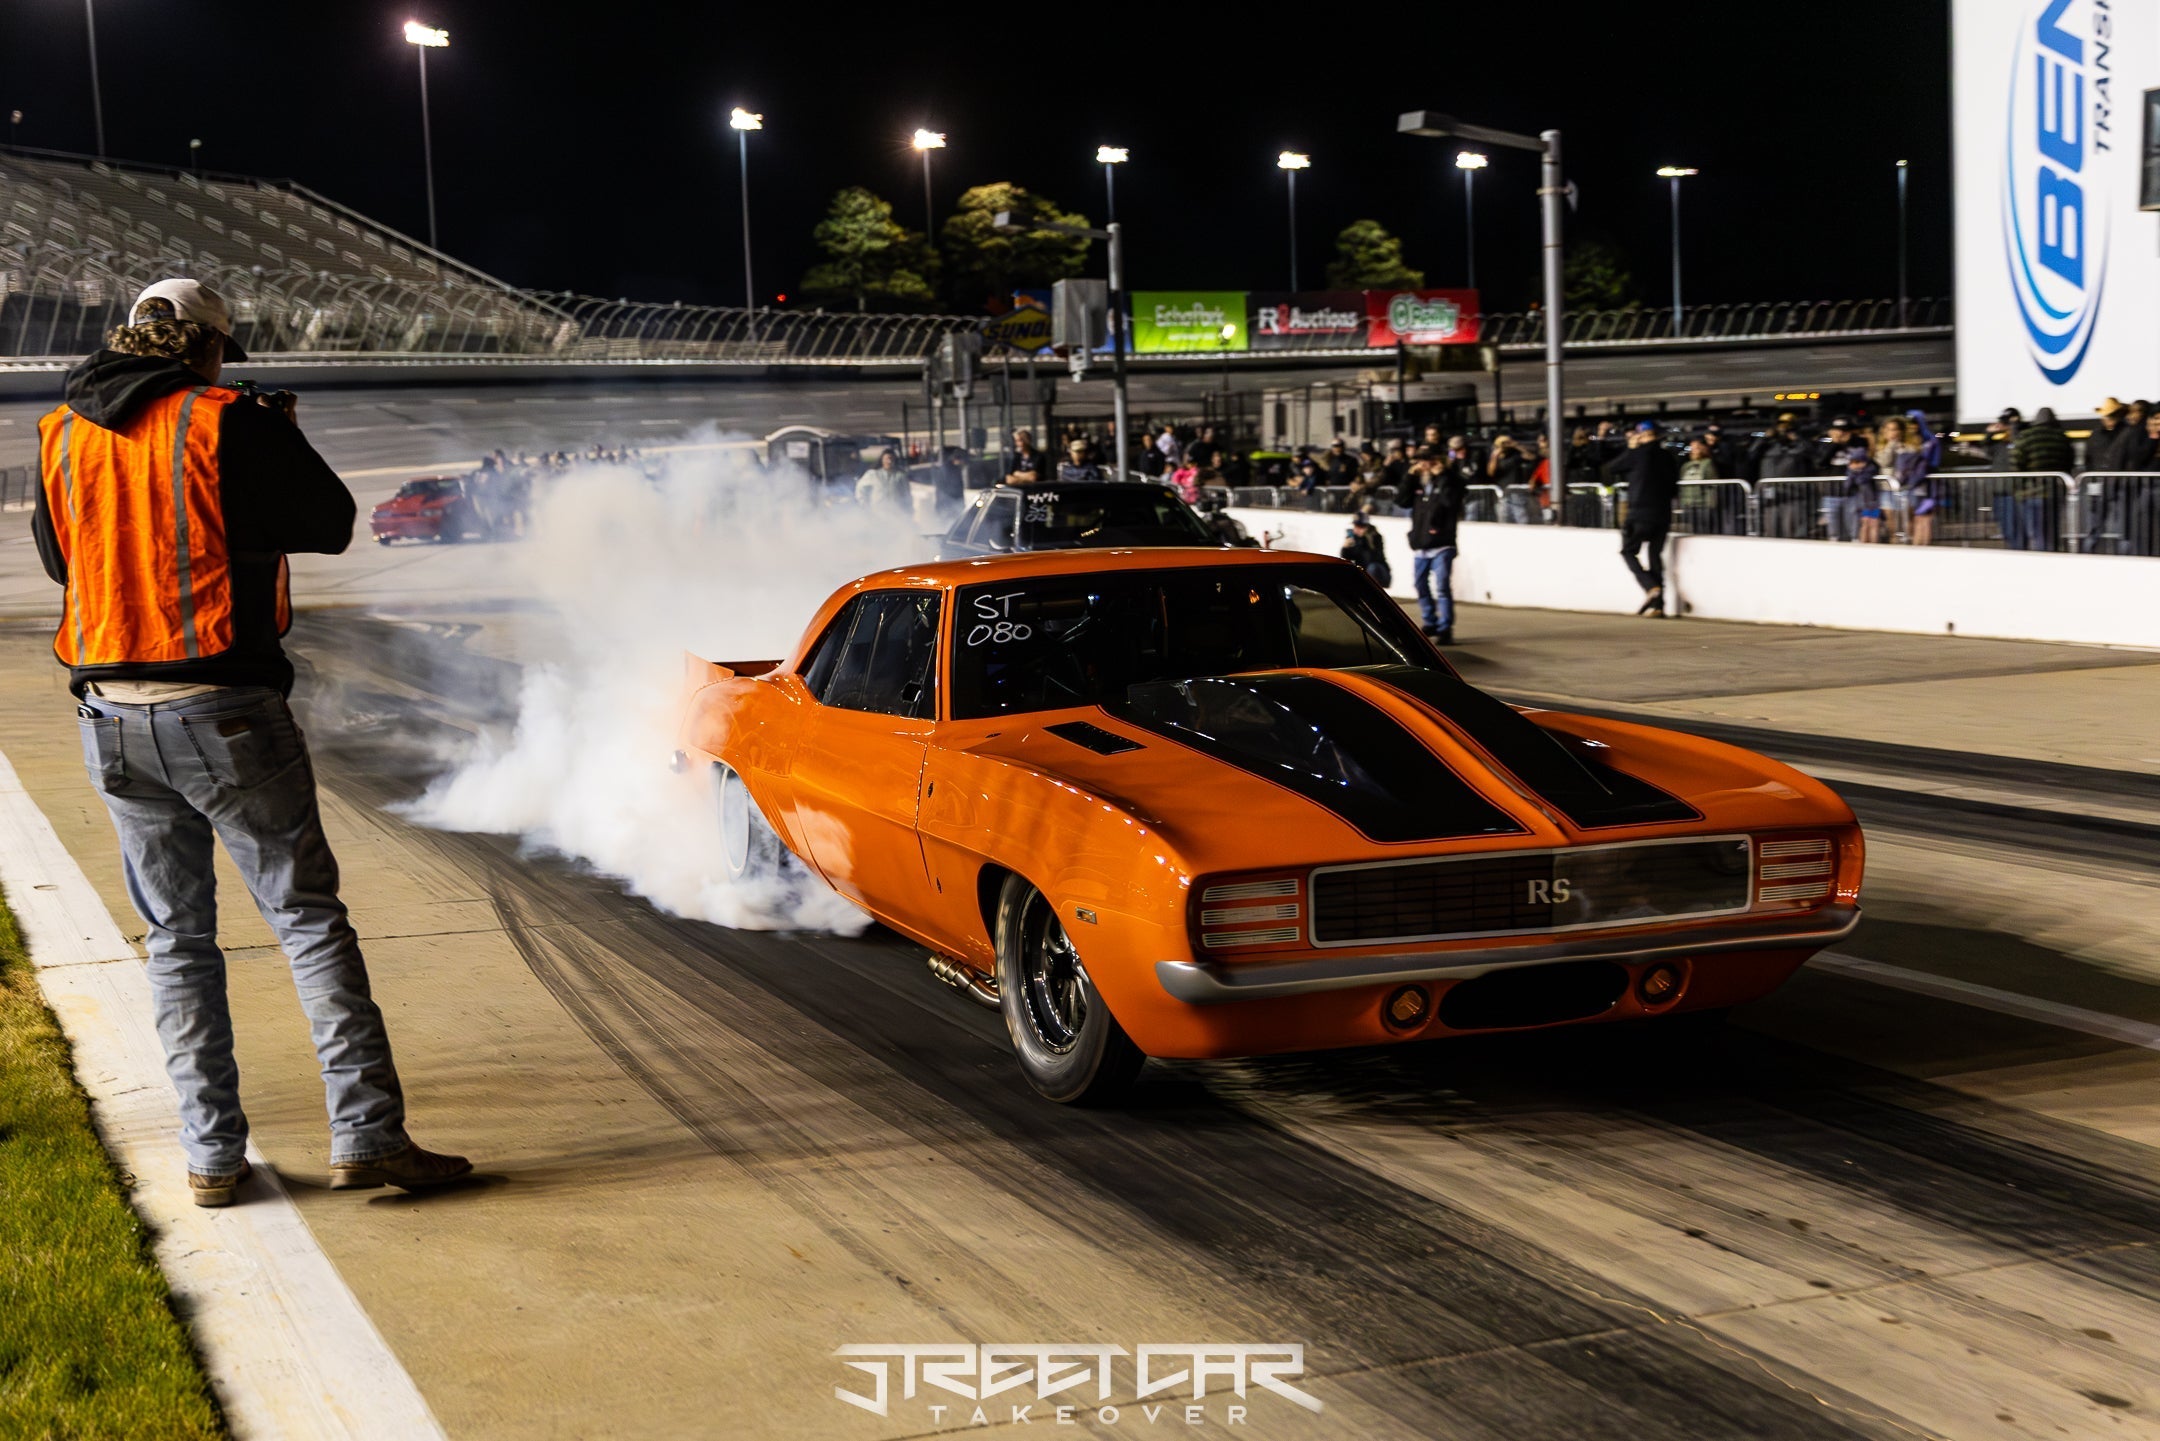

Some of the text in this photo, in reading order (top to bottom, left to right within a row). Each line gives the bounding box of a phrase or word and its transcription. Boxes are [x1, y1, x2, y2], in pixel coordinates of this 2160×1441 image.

[988, 321, 1052, 340] SUNO
[974, 592, 1025, 619] ST
[967, 622, 1032, 646] 080
[1528, 878, 1570, 904] RS
